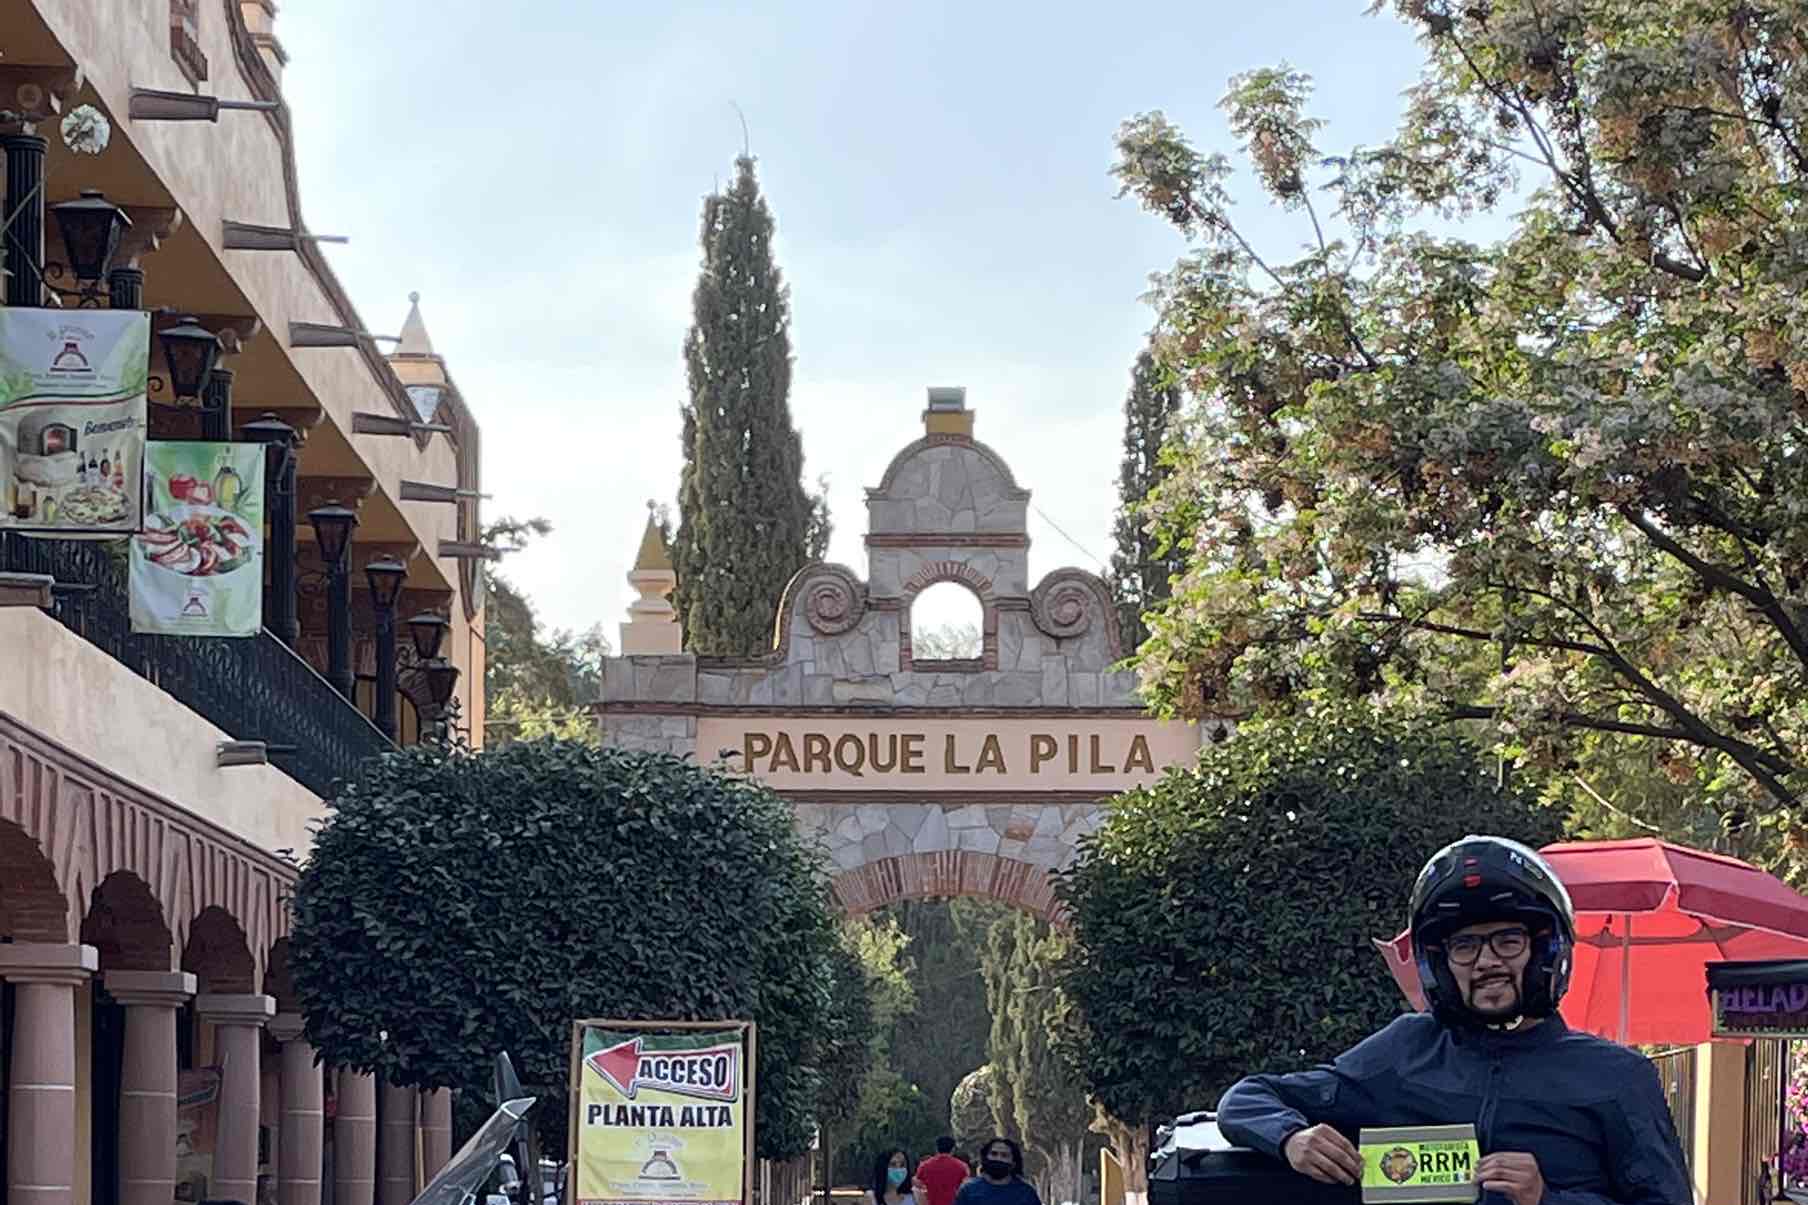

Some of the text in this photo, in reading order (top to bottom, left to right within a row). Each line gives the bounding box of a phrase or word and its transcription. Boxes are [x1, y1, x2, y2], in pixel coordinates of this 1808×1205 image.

[743, 731, 1155, 777] PARQUE LA PILA
[639, 1055, 727, 1088] ACCESO
[587, 1103, 733, 1127] PLANTA ALTA
[1420, 1151, 1470, 1172] RRM
